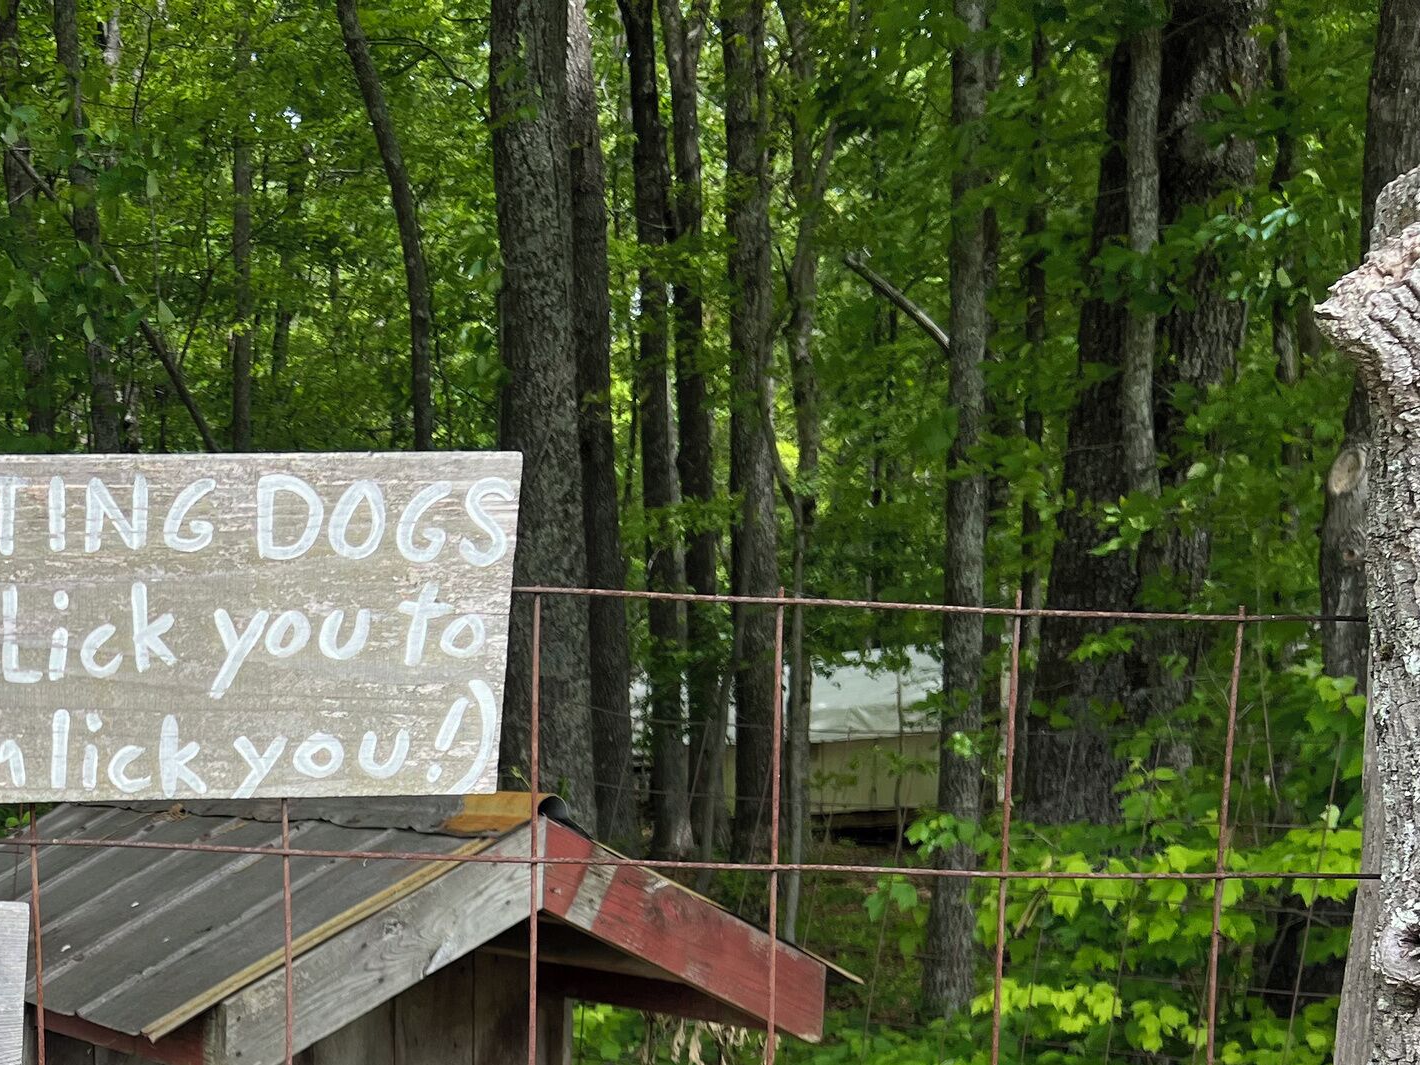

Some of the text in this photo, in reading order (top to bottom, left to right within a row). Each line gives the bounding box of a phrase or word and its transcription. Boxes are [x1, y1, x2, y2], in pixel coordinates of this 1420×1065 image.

[257, 472, 517, 568] DOGS
[209, 607, 372, 699] you
[398, 581, 486, 666] to
